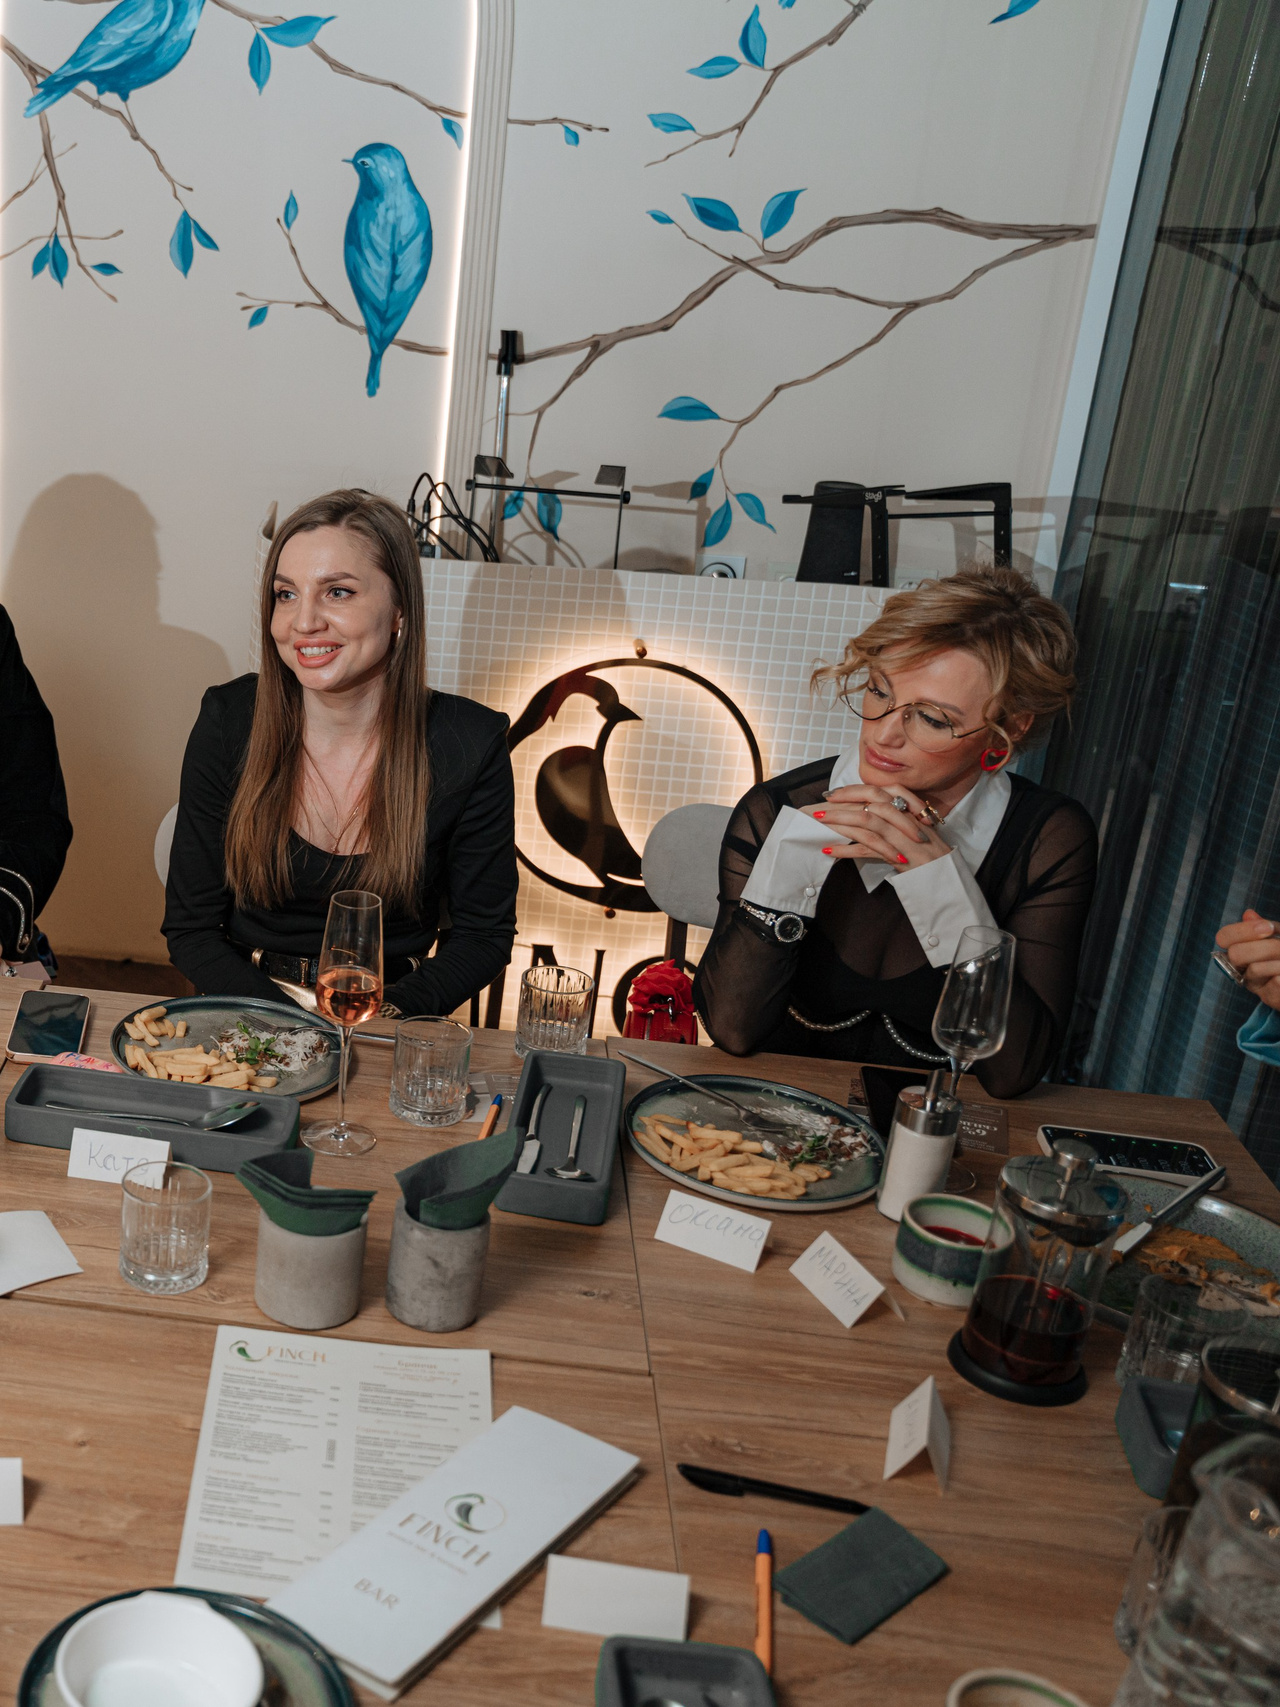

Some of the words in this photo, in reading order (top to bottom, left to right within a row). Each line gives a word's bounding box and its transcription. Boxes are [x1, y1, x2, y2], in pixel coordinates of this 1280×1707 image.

[266, 1345, 327, 1363] FINCH
[398, 1512, 491, 1566] FINCH
[353, 1577, 400, 1611] BAR
